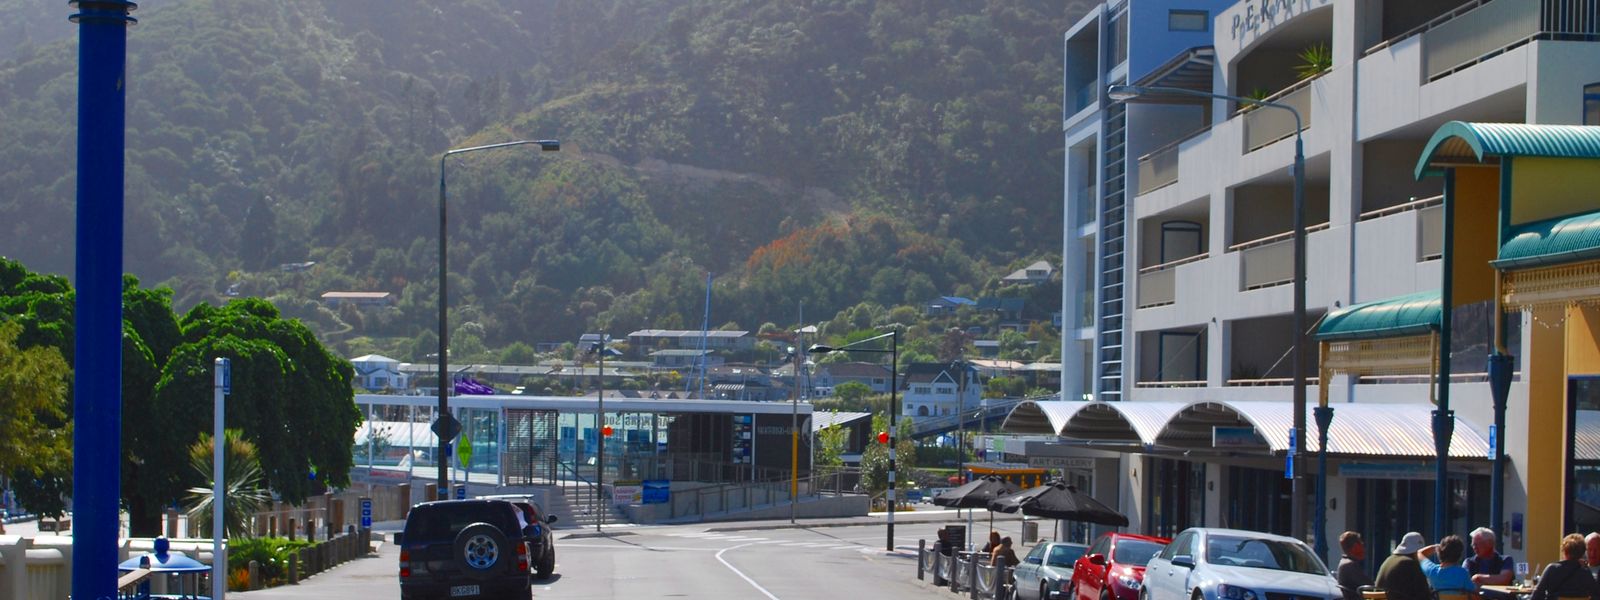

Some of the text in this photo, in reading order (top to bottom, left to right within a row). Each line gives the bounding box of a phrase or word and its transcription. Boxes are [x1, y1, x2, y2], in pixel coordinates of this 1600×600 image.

[1033, 458, 1093, 467] ART GALLERY
[1519, 563, 1527, 572] 31
